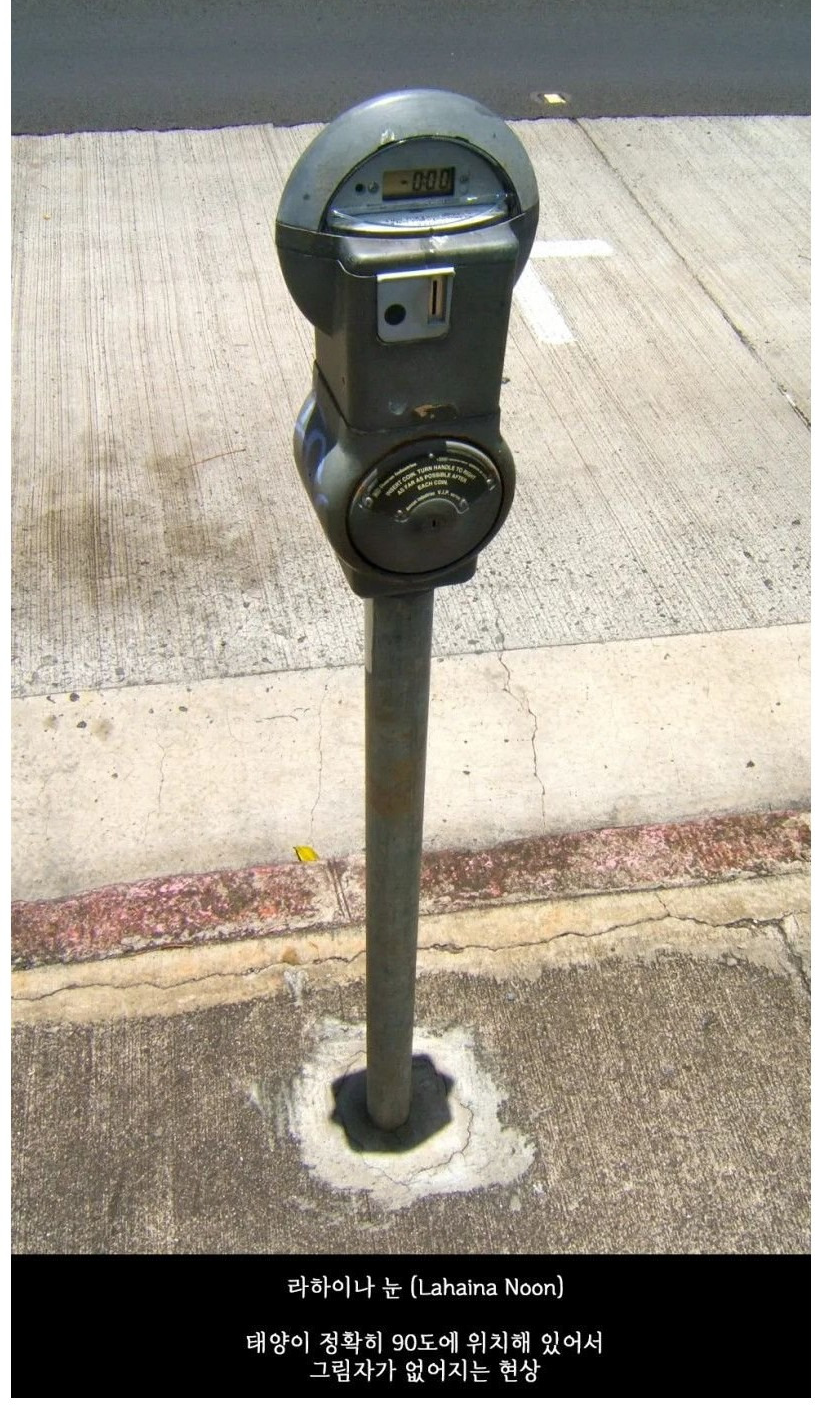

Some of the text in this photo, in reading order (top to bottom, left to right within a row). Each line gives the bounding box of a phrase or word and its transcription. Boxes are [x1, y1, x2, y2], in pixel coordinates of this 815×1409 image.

[417, 466, 432, 474] TURN
[424, 471, 451, 479] POSSIBLE
[417, 481, 433, 491] EACH
